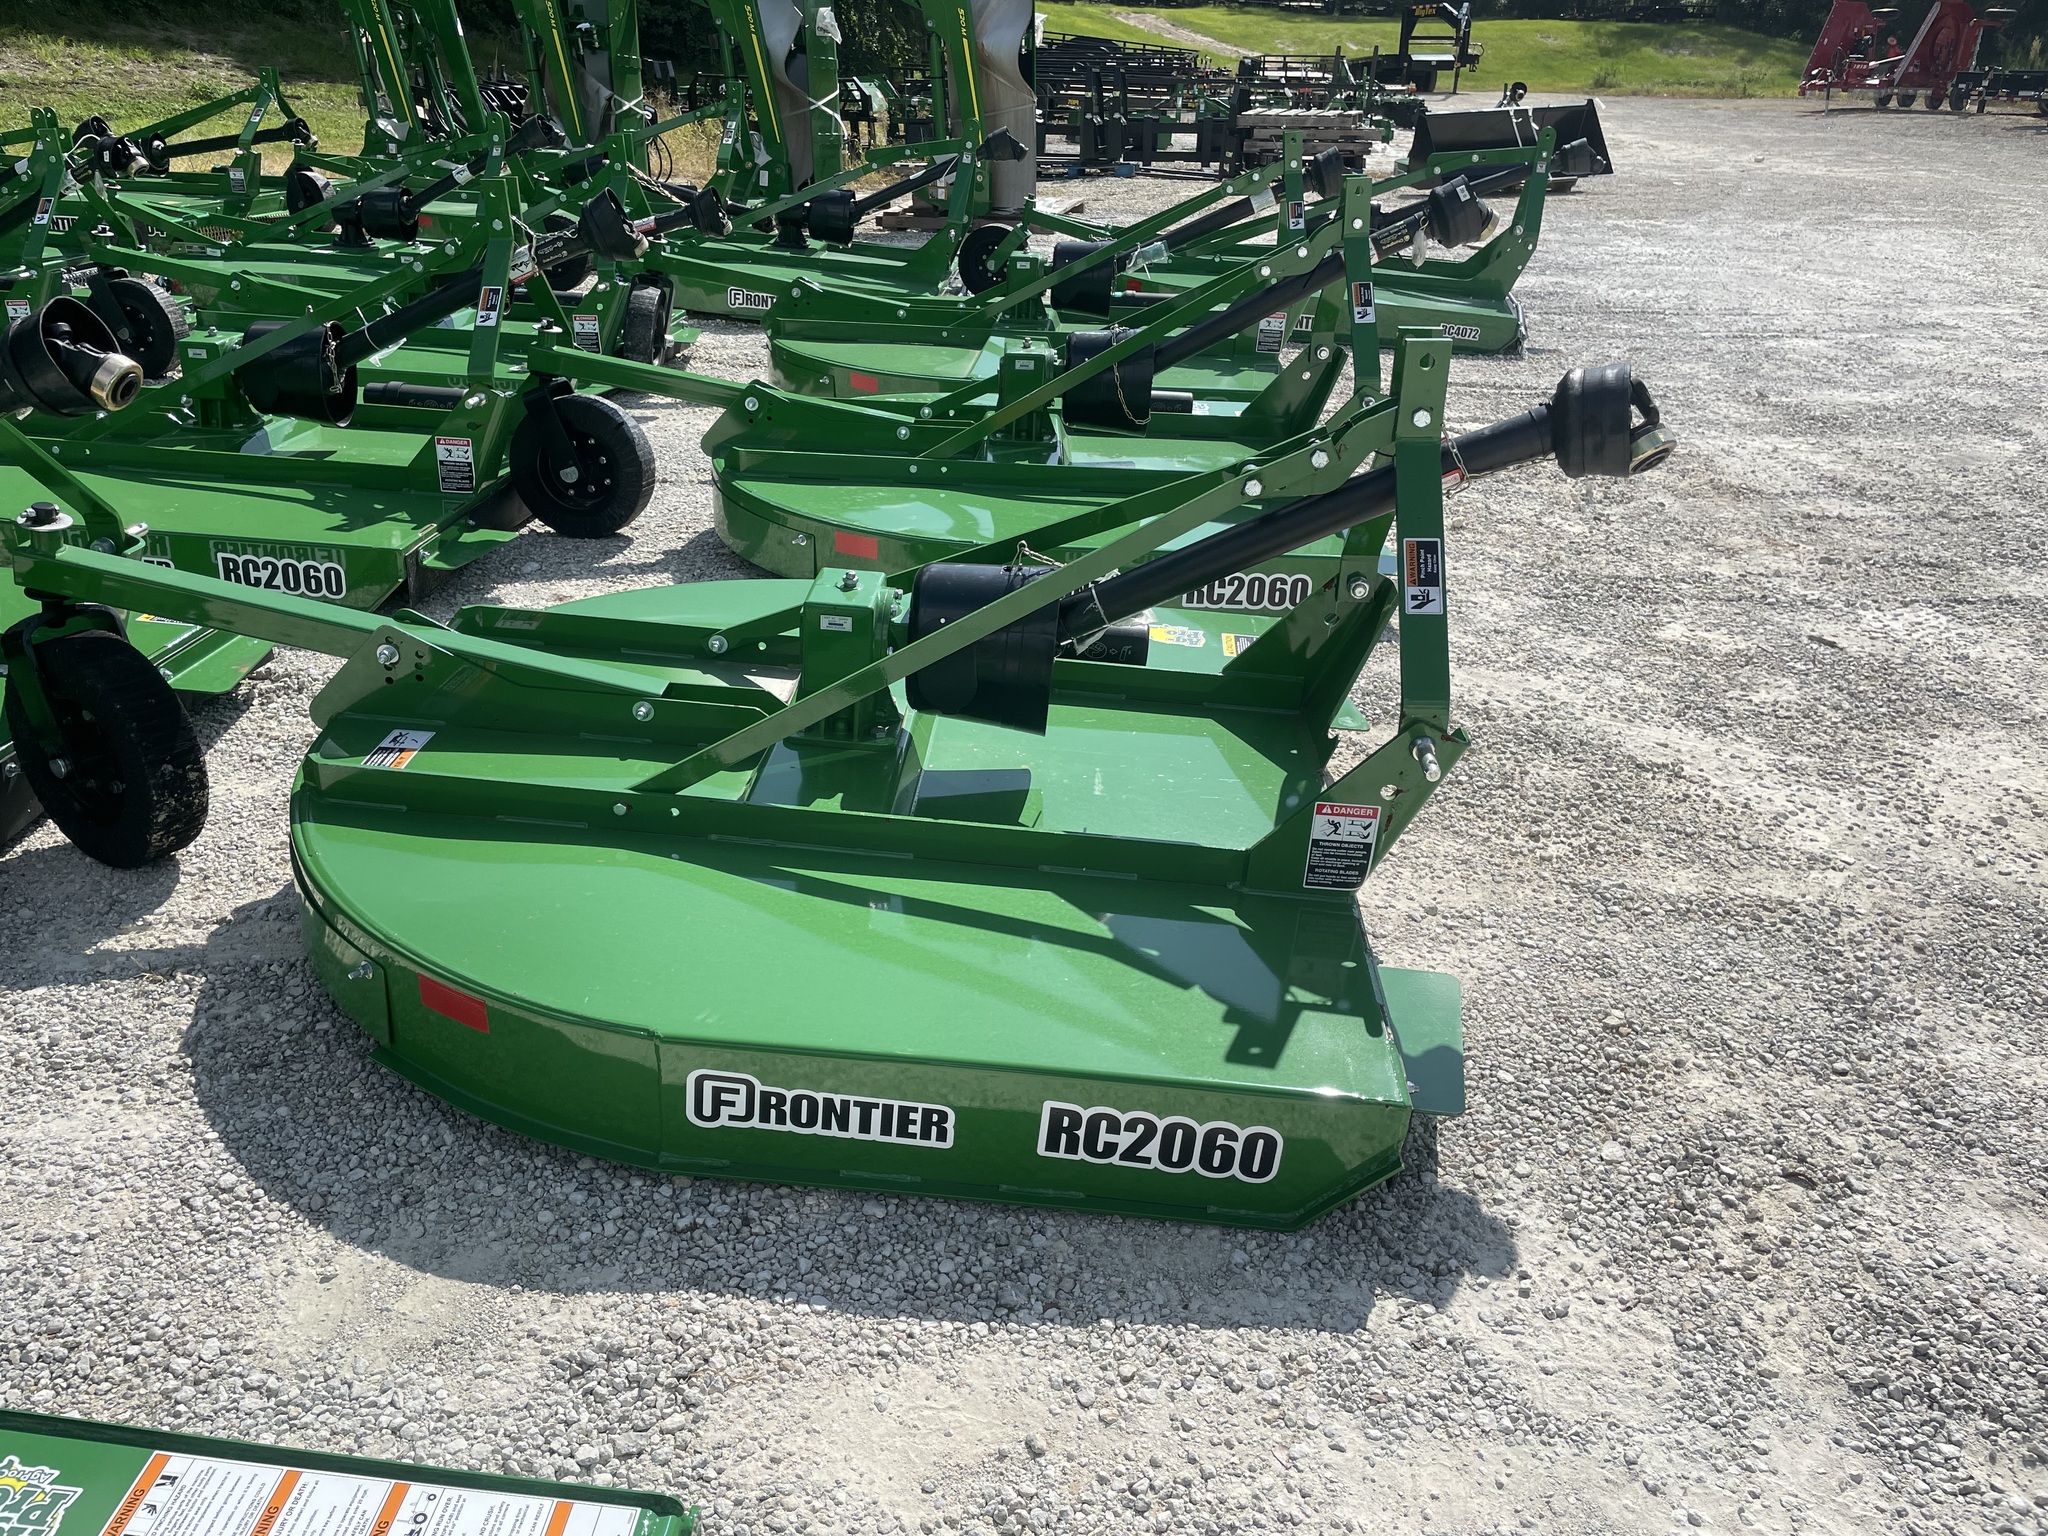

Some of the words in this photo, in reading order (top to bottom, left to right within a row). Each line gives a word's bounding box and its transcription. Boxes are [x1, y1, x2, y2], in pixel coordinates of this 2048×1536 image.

[371, 0, 381, 21] 20M
[730, 288, 776, 308] FRONT
[1333, 806, 1373, 816] DANGER
[694, 1073, 948, 1143] FRONTIER
[1045, 1109, 1277, 1180] RC2060
[154, 1506, 173, 1530] PINCHING
[171, 1484, 186, 1505] HAZARD
[285, 1506, 295, 1516] OR
[358, 1509, 367, 1520] CAN
[435, 1514, 445, 1526] RUN
